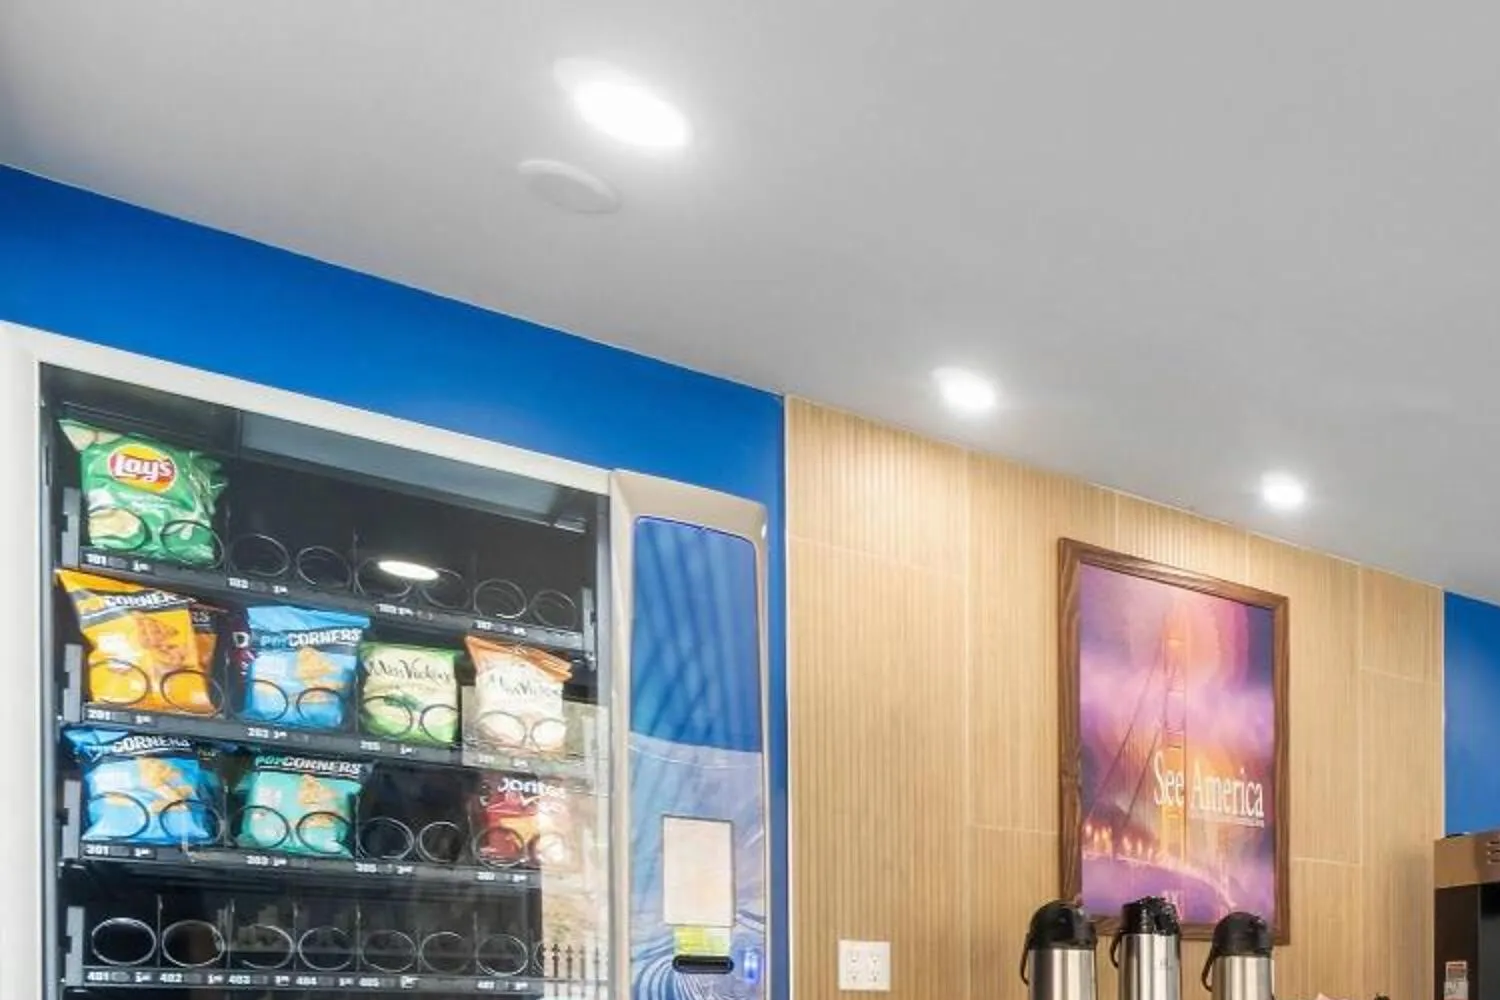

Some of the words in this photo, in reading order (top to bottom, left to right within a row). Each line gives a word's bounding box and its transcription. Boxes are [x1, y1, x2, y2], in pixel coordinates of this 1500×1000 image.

[114, 453, 173, 482] Lay's
[1153, 751, 1184, 808] See
[1189, 757, 1265, 819] America
